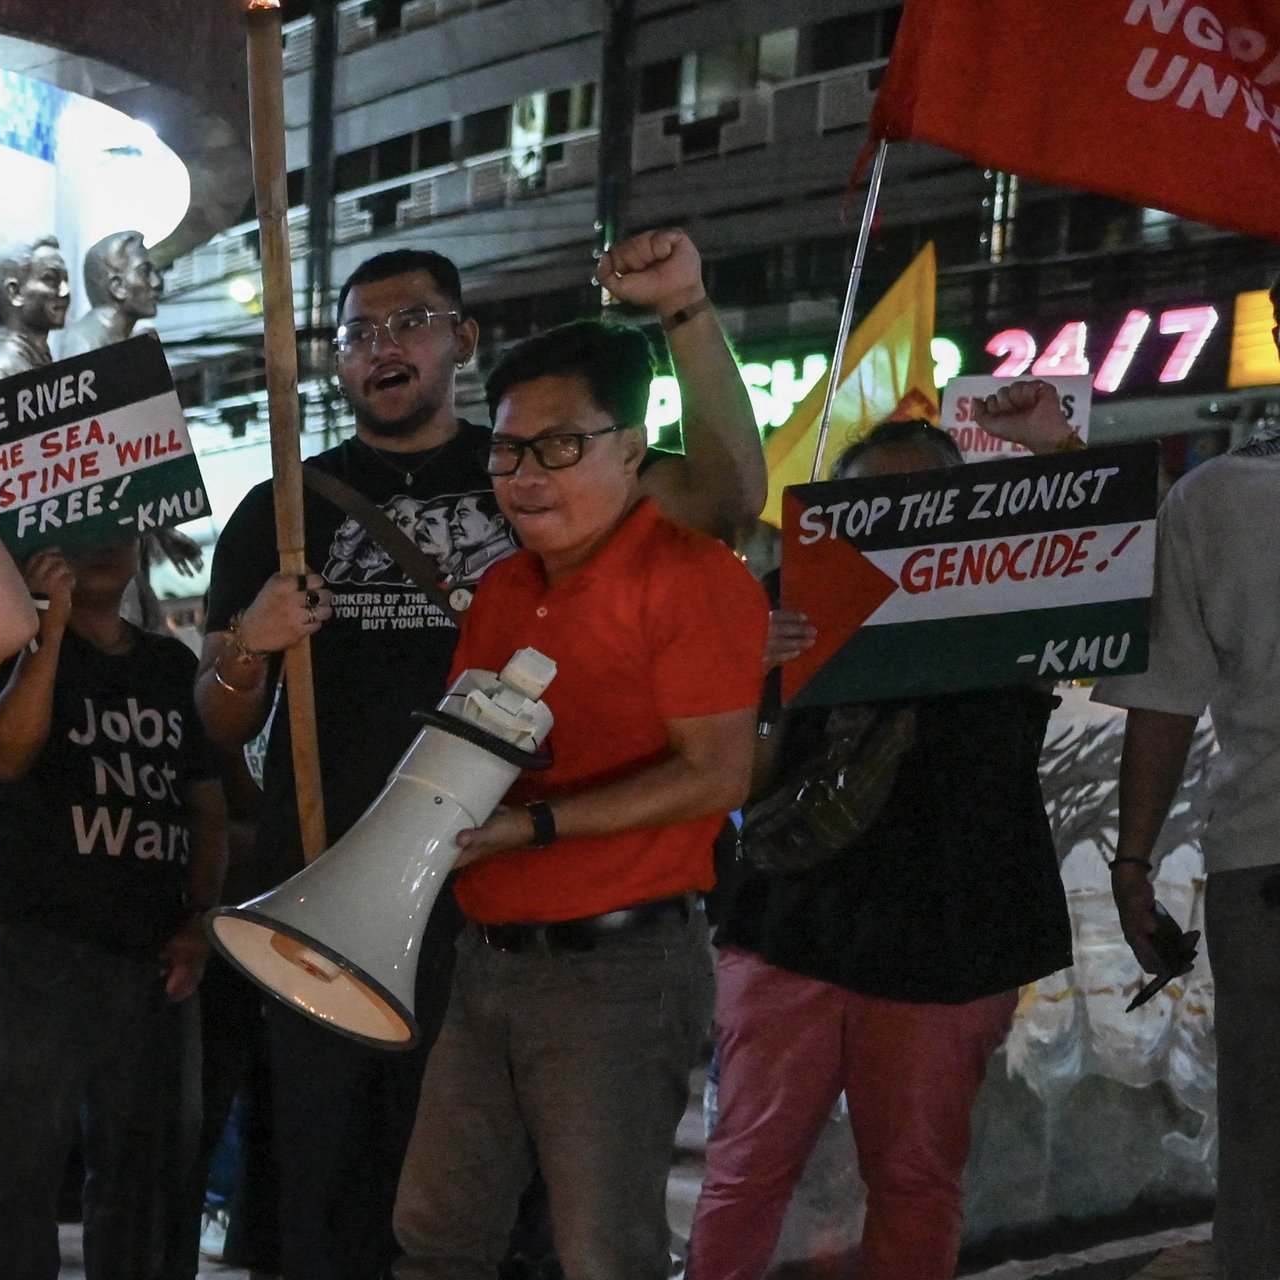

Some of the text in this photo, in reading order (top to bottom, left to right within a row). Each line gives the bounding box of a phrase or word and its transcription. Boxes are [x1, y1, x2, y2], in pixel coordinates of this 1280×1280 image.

[985, 304, 1220, 393] 24/7
[17, 369, 98, 424] RIVER
[40, 419, 116, 459] SEA,
[116, 429, 182, 467] WILL
[17, 475, 132, 539] FREE!
[118, 487, 205, 532] -KMU
[798, 467, 1120, 545] STOP THE ZIONIST
[899, 525, 1142, 595] GENOCIDE!
[332, 593, 382, 605] ORKERS
[383, 594, 401, 605] OF
[335, 606, 359, 618] YOU
[362, 605, 396, 618] HAVE
[361, 618, 388, 631] BUT
[390, 617, 424, 629] YOUR
[1017, 633, 1131, 676] -KMU
[67, 698, 183, 749] Jobs
[91, 752, 182, 806] Not
